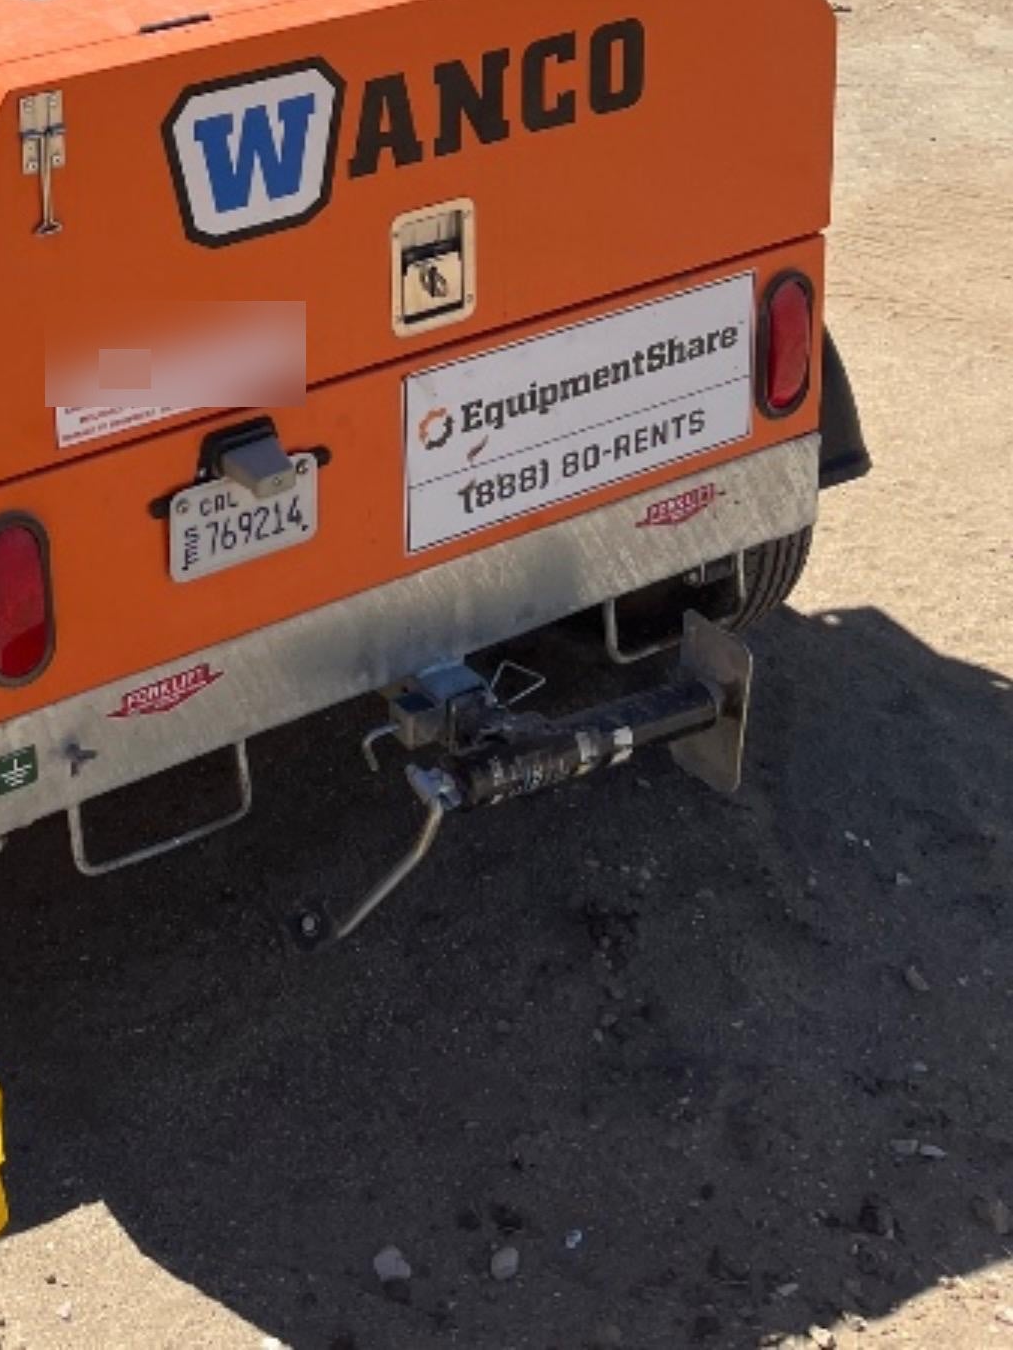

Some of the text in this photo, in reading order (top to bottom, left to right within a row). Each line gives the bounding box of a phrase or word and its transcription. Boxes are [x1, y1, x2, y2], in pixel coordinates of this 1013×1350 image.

[194, 17, 646, 214] WANCO
[460, 325, 738, 432] EquipmentShare
[200, 491, 238, 516] CAL
[458, 409, 706, 514] (888) 80-RENTS
[206, 496, 303, 555] 769214
